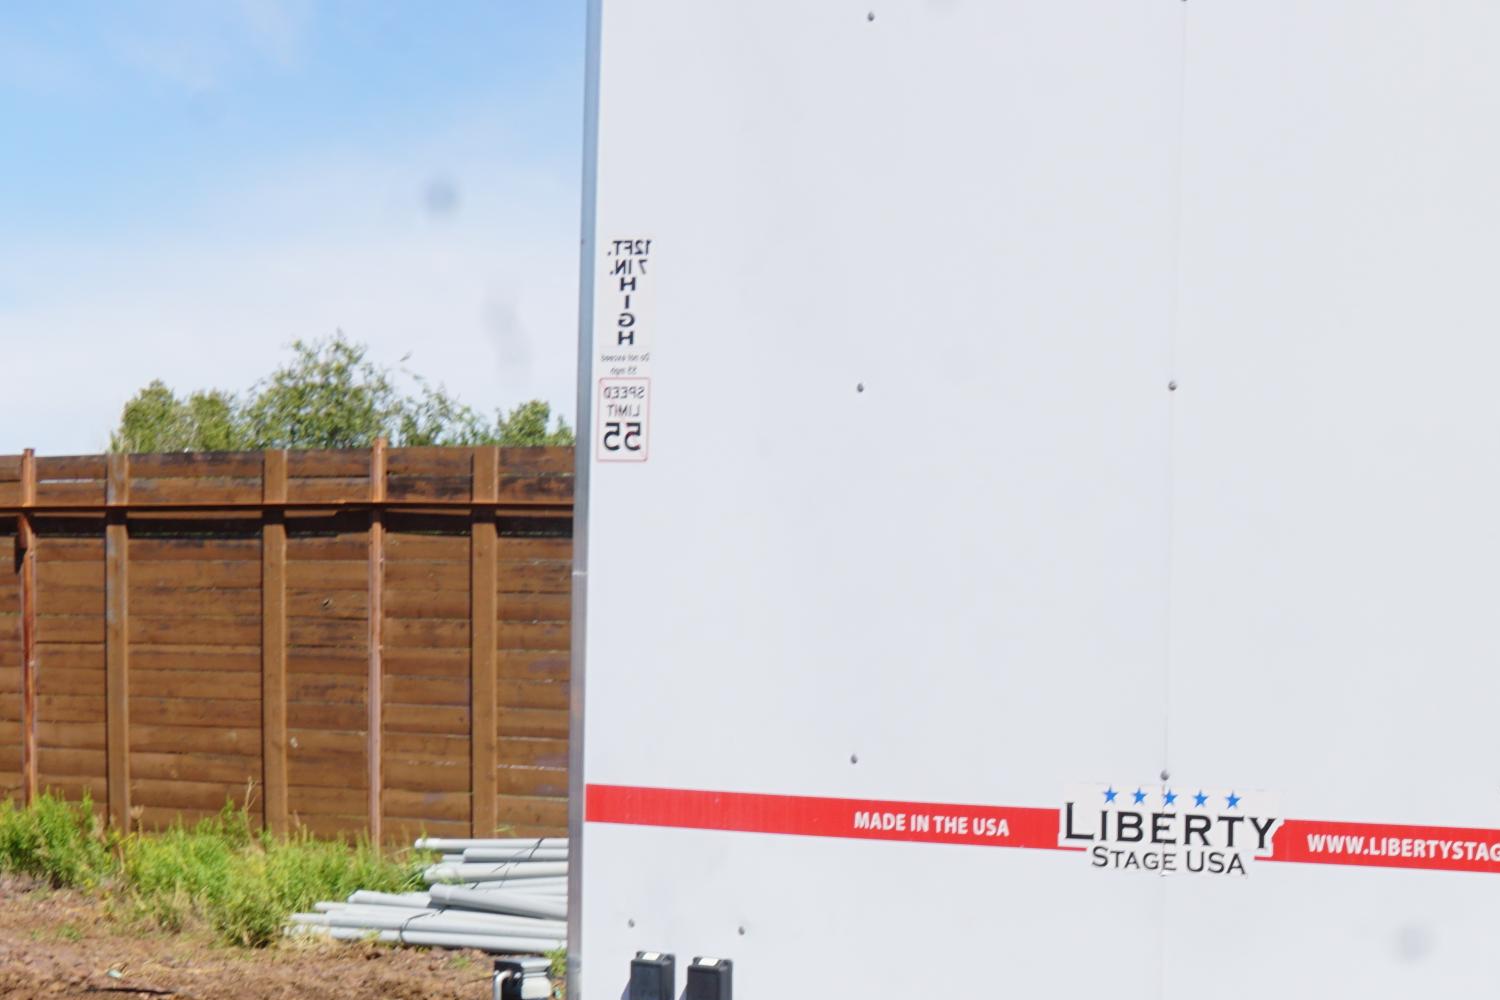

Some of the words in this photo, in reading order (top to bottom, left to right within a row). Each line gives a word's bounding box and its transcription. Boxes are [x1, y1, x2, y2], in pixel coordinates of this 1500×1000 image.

[853, 811, 906, 832] MADE
[910, 814, 930, 833] IN
[933, 815, 969, 835] THE
[973, 817, 1010, 837] USA
[1064, 801, 1277, 850] LIBERTY
[1091, 845, 1177, 872] STAGE
[1186, 850, 1247, 875] USA
